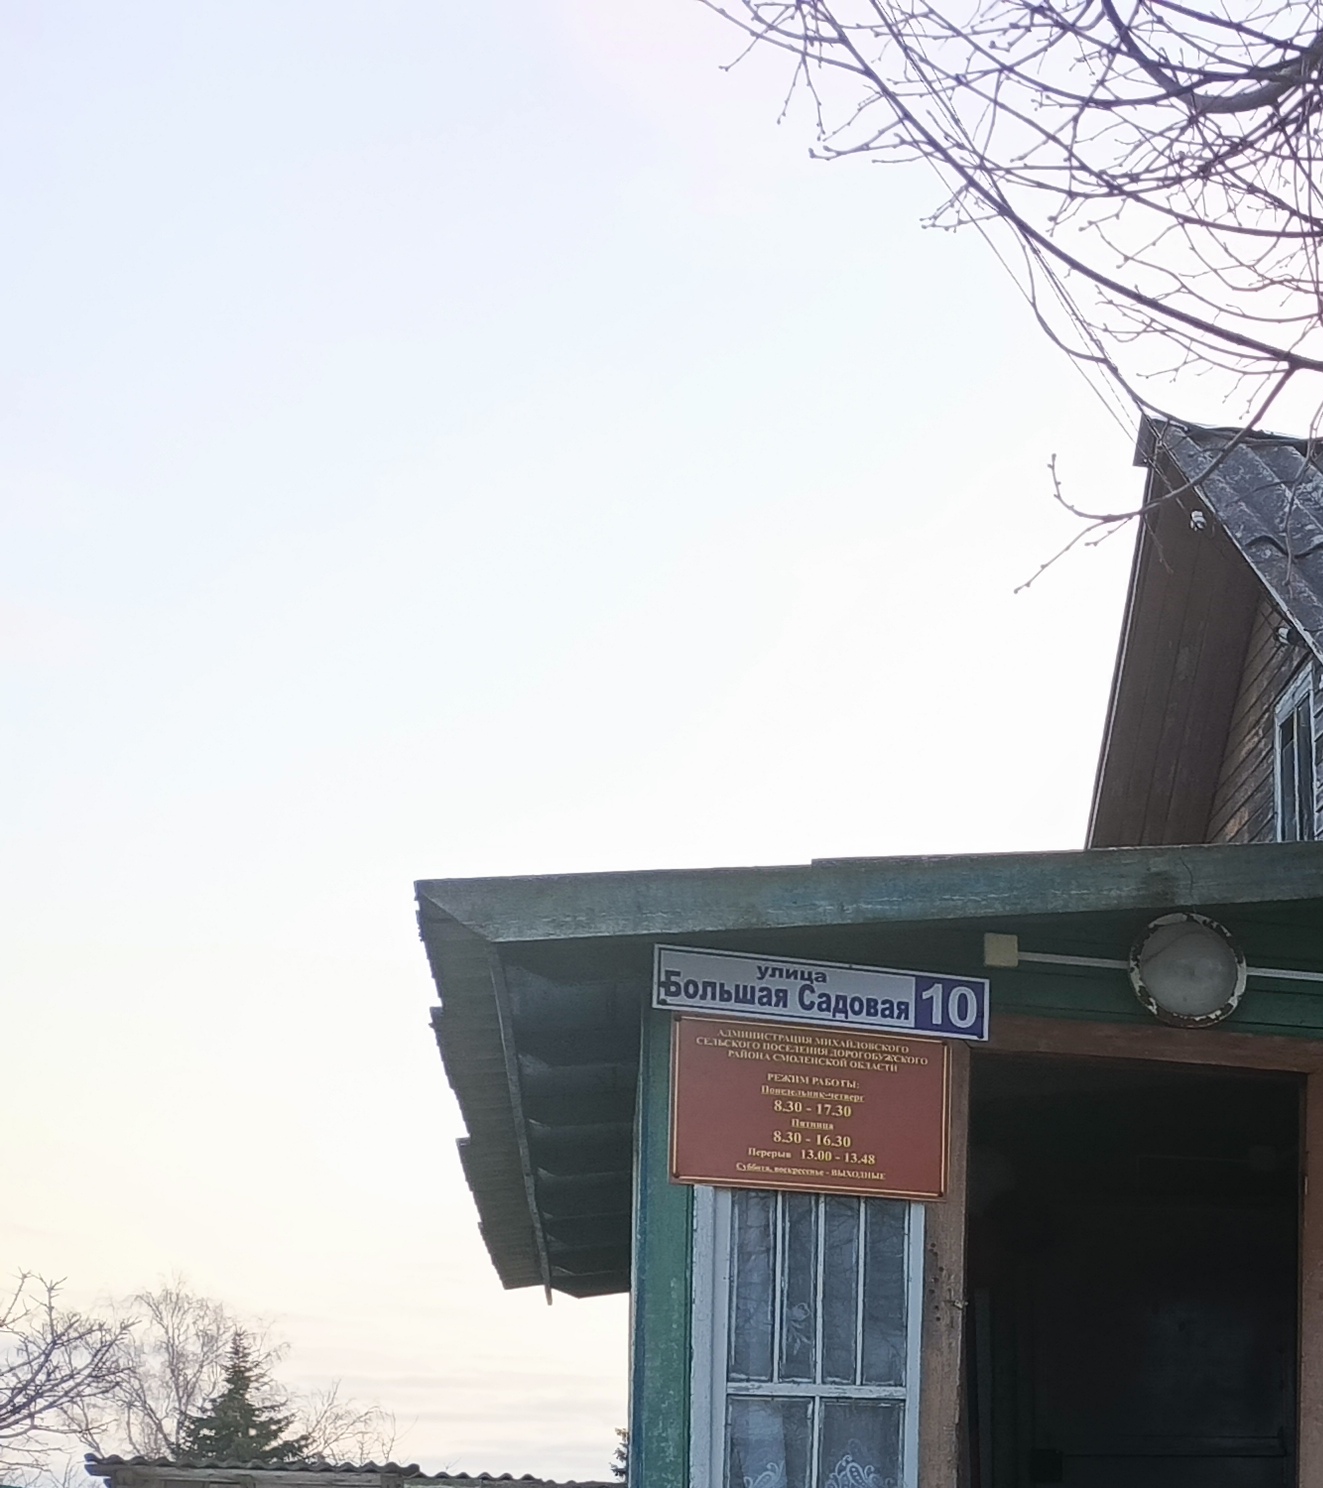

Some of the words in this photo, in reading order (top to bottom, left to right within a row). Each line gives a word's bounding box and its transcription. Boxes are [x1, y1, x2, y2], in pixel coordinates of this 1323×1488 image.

[757, 964, 828, 985] улица
[662, 970, 789, 1009] Большая
[798, 984, 910, 1021] Садовая
[922, 983, 978, 1029] 10
[717, 1029, 813, 1044] АДМИНИСТРАЦИЯ
[814, 1037, 909, 1053] МИХАЙЛОВСКОГО
[696, 1037, 761, 1050] СЕЛЬСКОГО
[763, 1042, 828, 1056] ПОСЕЛЕНИЯ
[830, 1048, 928, 1065] ДОРОГОБУЖСКОГО
[728, 1050, 771, 1061] РАЙОНА
[772, 1053, 847, 1068] СМОЛЕНСКОЙ
[849, 1060, 898, 1072] ОБЛАСТИ
[767, 1073, 809, 1085] РЕЖИМ
[812, 1076, 860, 1089] РАБОТЫ:
[774, 1100, 802, 1112] 8.30
[817, 1103, 852, 1117] 17.30
[791, 1118, 834, 1130] Пятница
[773, 1130, 802, 1143] 8.30
[816, 1134, 851, 1147] 16.30
[748, 1147, 792, 1159] Перерыв
[801, 1149, 832, 1161] 13.00
[844, 1152, 875, 1165] 13.48
[831, 1169, 886, 1180] ВЫХОДНЫЕ
